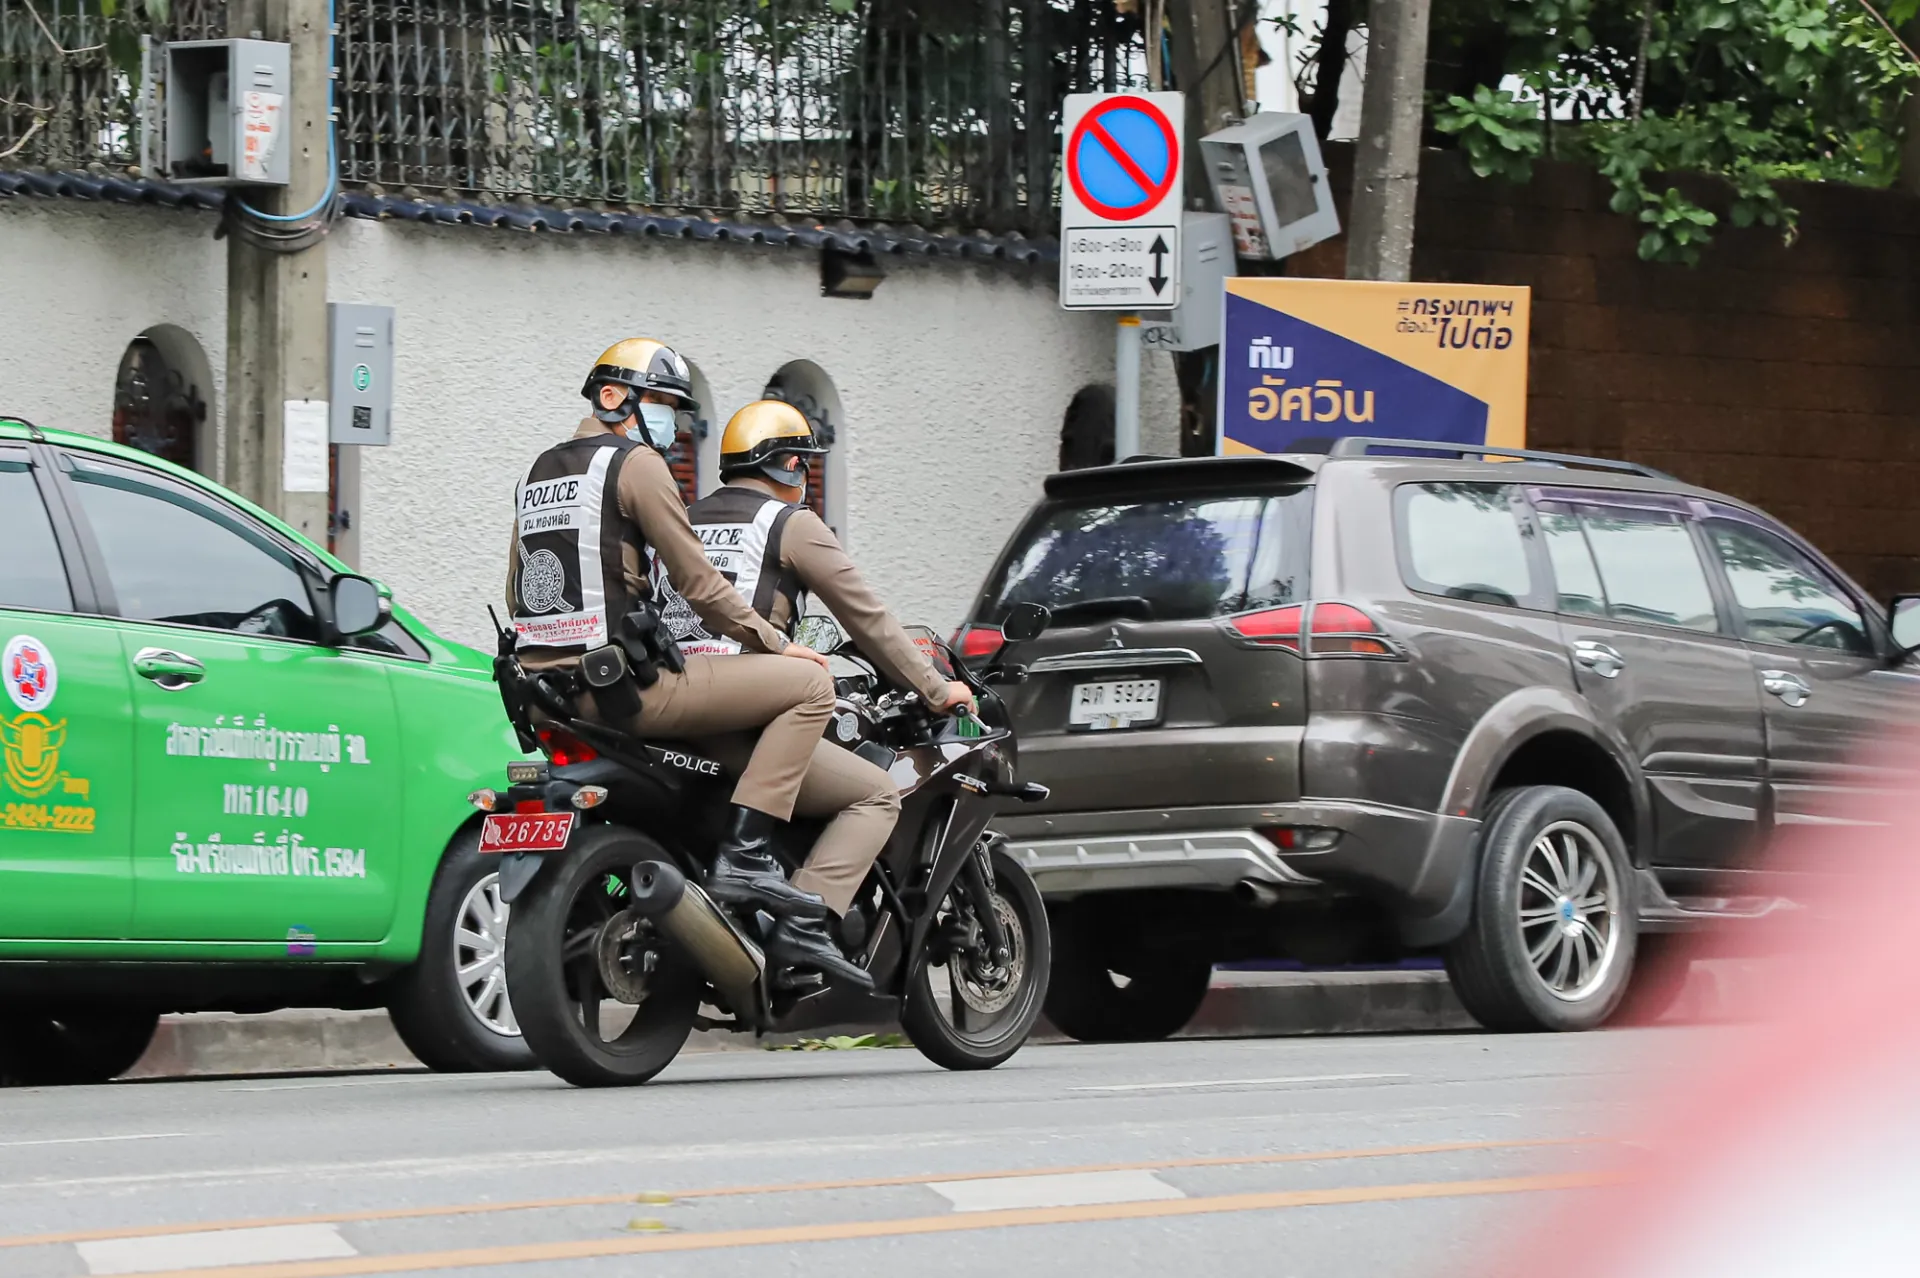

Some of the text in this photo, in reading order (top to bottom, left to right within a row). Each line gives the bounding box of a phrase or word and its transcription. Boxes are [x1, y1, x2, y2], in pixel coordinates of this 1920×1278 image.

[1438, 317, 1513, 350] ไปต่อ
[1248, 336, 1295, 370] ทีม
[1248, 374, 1375, 423] อัศวิน
[522, 481, 579, 509] POLICE
[695, 528, 744, 546] LICE
[1115, 683, 1156, 703] 5922
[662, 751, 720, 776] POLICE
[505, 819, 569, 843] 26735
